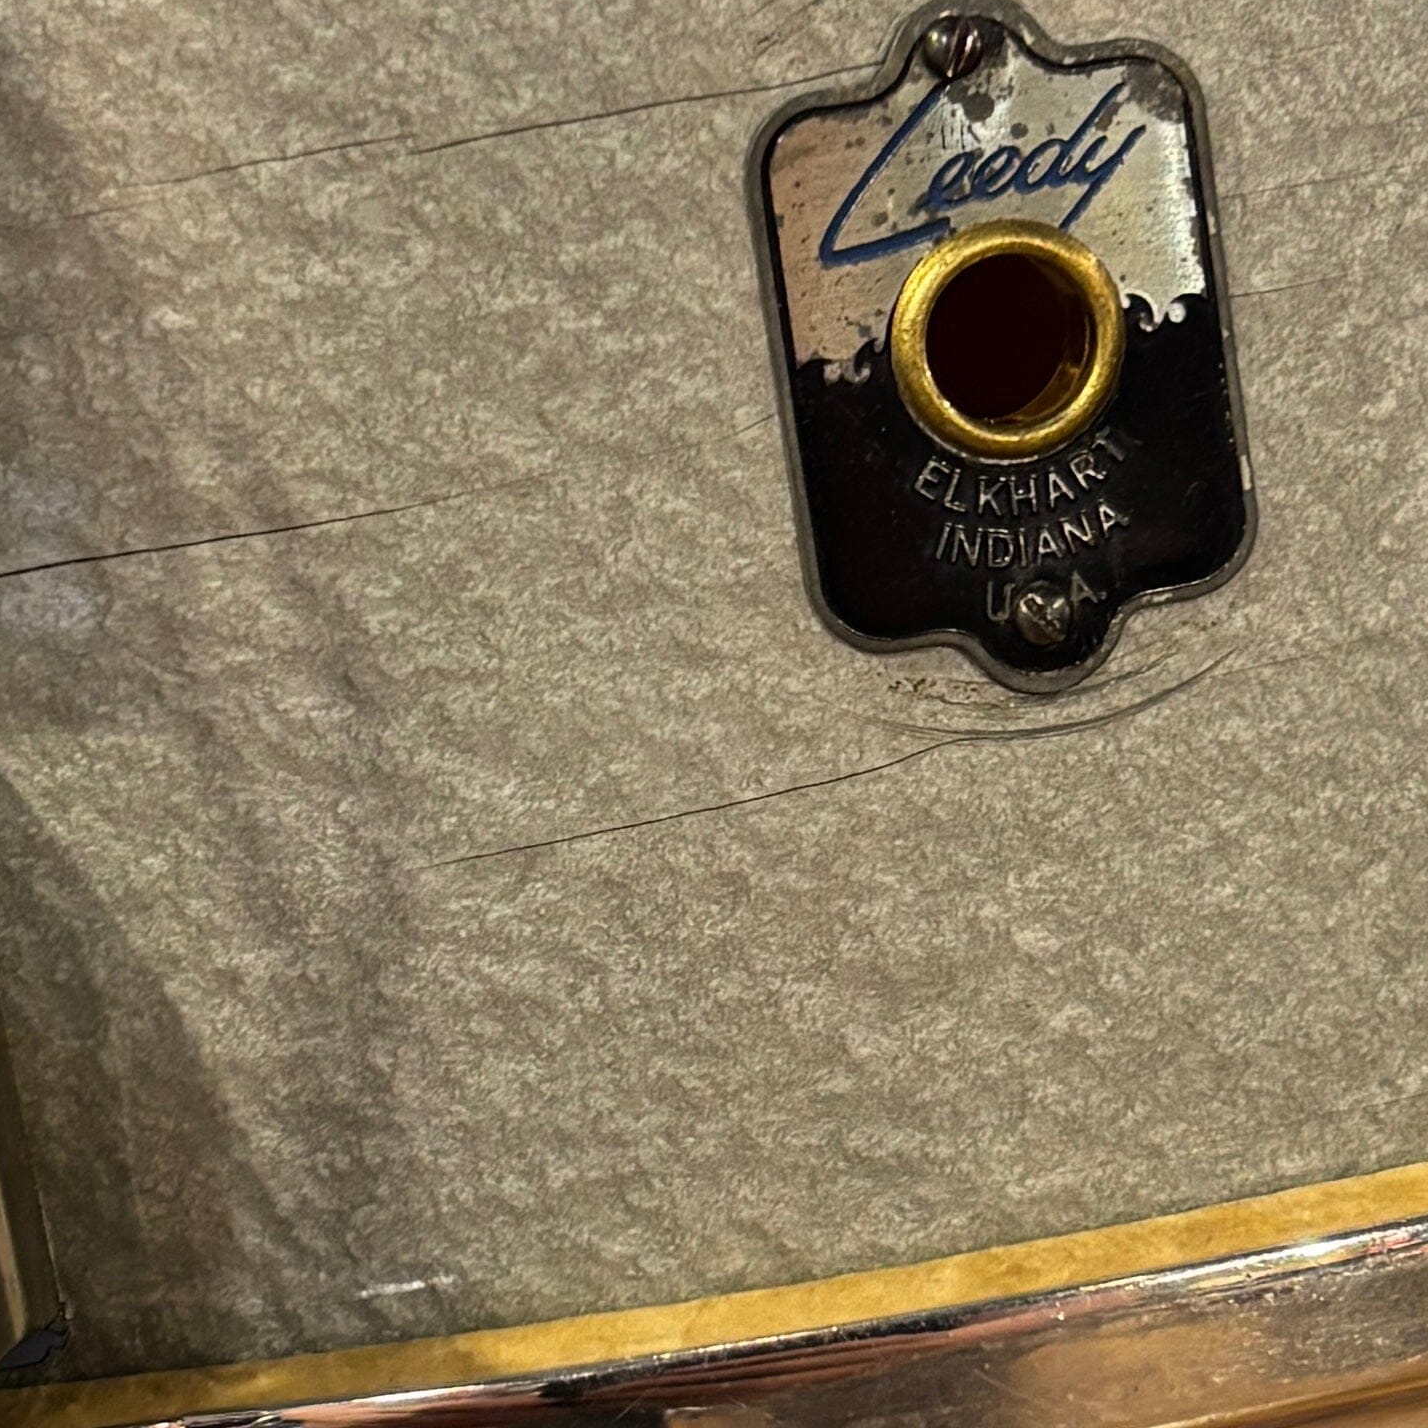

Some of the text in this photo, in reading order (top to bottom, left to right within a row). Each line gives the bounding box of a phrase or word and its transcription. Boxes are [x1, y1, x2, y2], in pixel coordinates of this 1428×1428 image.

[820, 80, 1147, 268] Leedy
[914, 426, 1128, 516] ELKHART
[935, 498, 1130, 568] INDIANA
